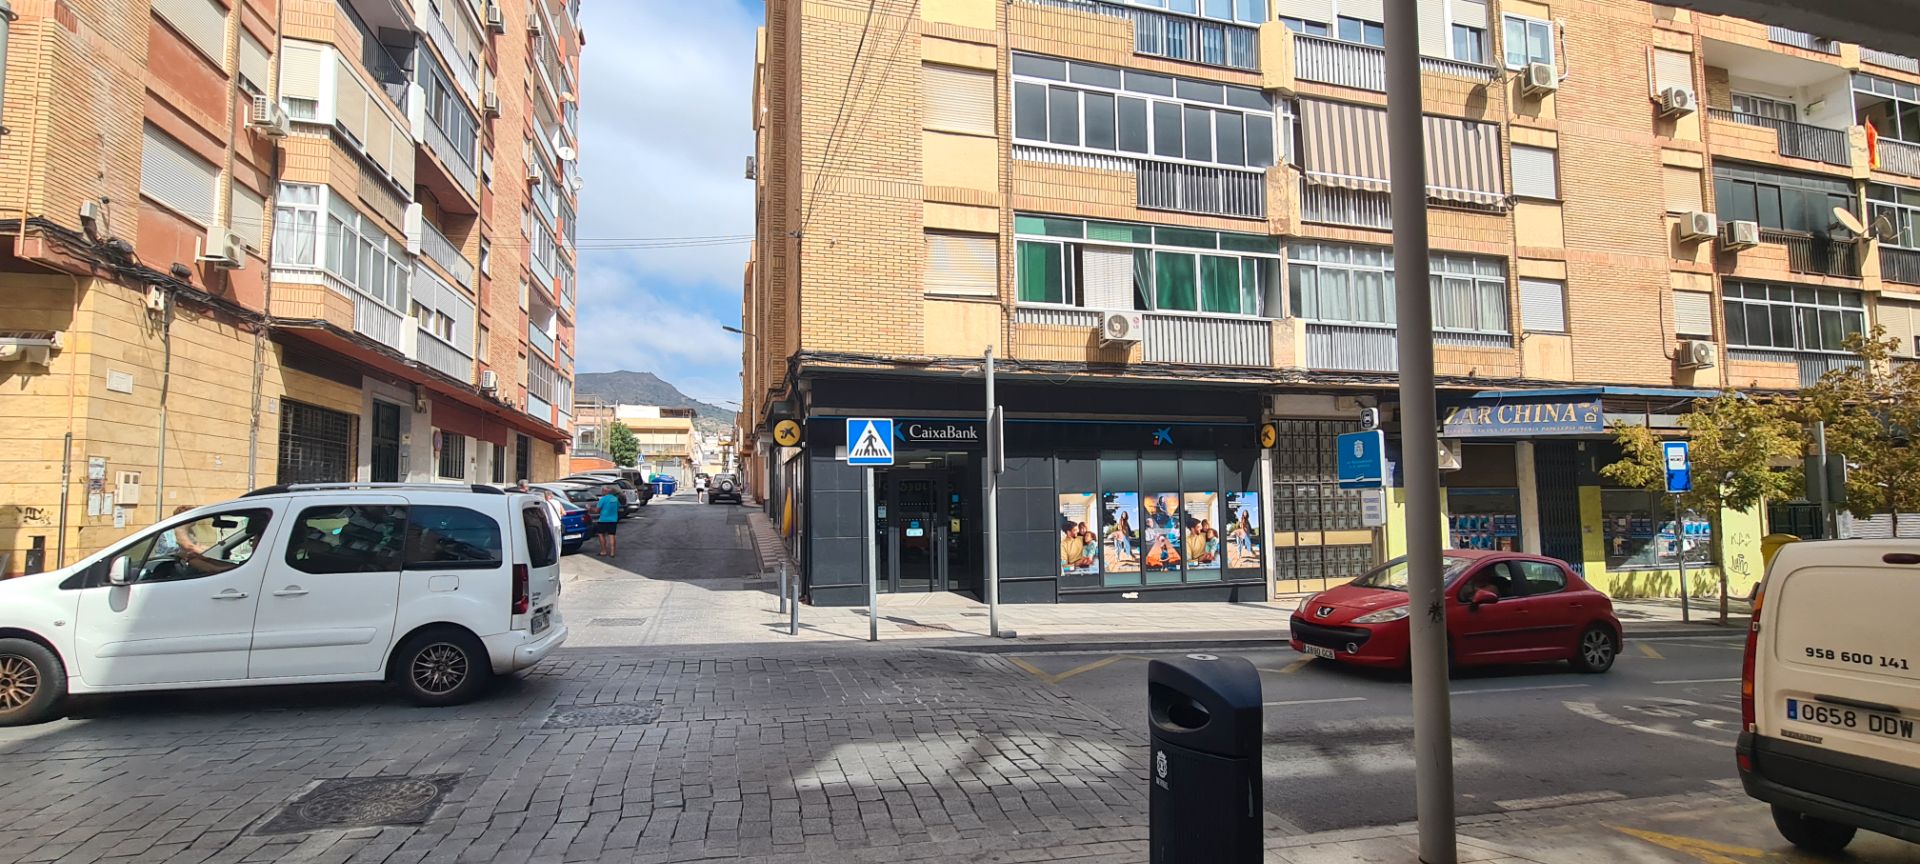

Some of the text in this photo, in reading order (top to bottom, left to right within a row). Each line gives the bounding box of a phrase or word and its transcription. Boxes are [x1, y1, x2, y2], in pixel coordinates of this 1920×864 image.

[1497, 403, 1577, 424] CHINA
[909, 424, 978, 439] CaixaBank
[1805, 647, 1909, 670] 958 600 141
[1802, 704, 1913, 738] 0658 DDW
